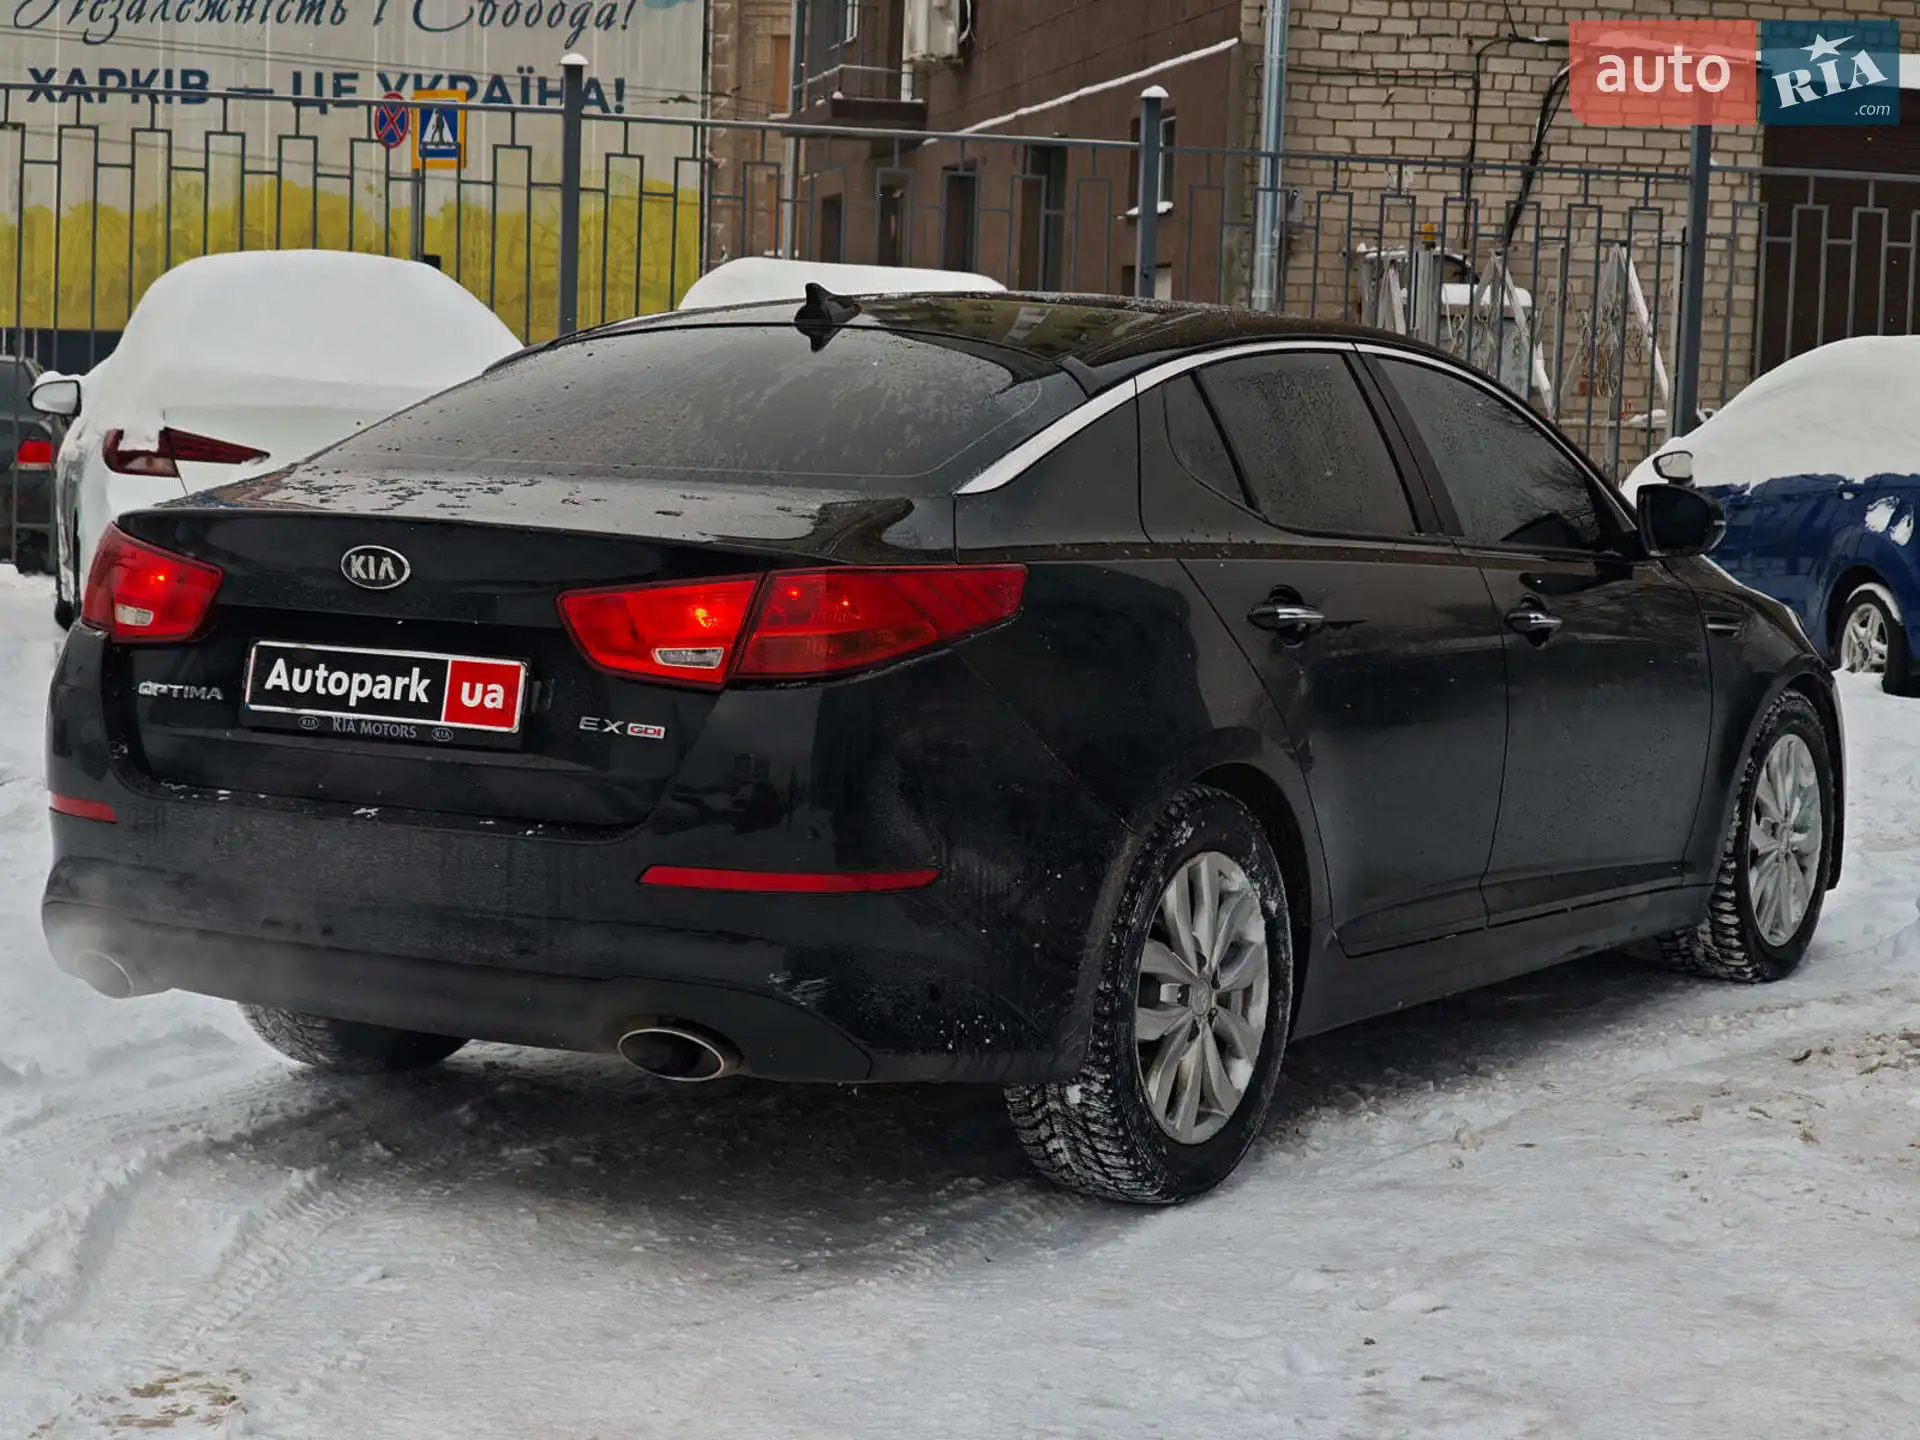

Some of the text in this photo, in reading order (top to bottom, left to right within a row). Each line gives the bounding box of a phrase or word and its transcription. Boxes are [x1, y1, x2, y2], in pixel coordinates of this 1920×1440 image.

[26, 67, 211, 105] ХАРКІВ
[291, 71, 360, 115] ЦЕ
[376, 65, 626, 115] УКРАЇНА!
[350, 554, 398, 581] KIA
[138, 680, 224, 701] OPTIMA
[264, 658, 505, 710] Autopark ua
[332, 717, 418, 739] KIA MOTORS
[579, 715, 663, 738] EX GDI
